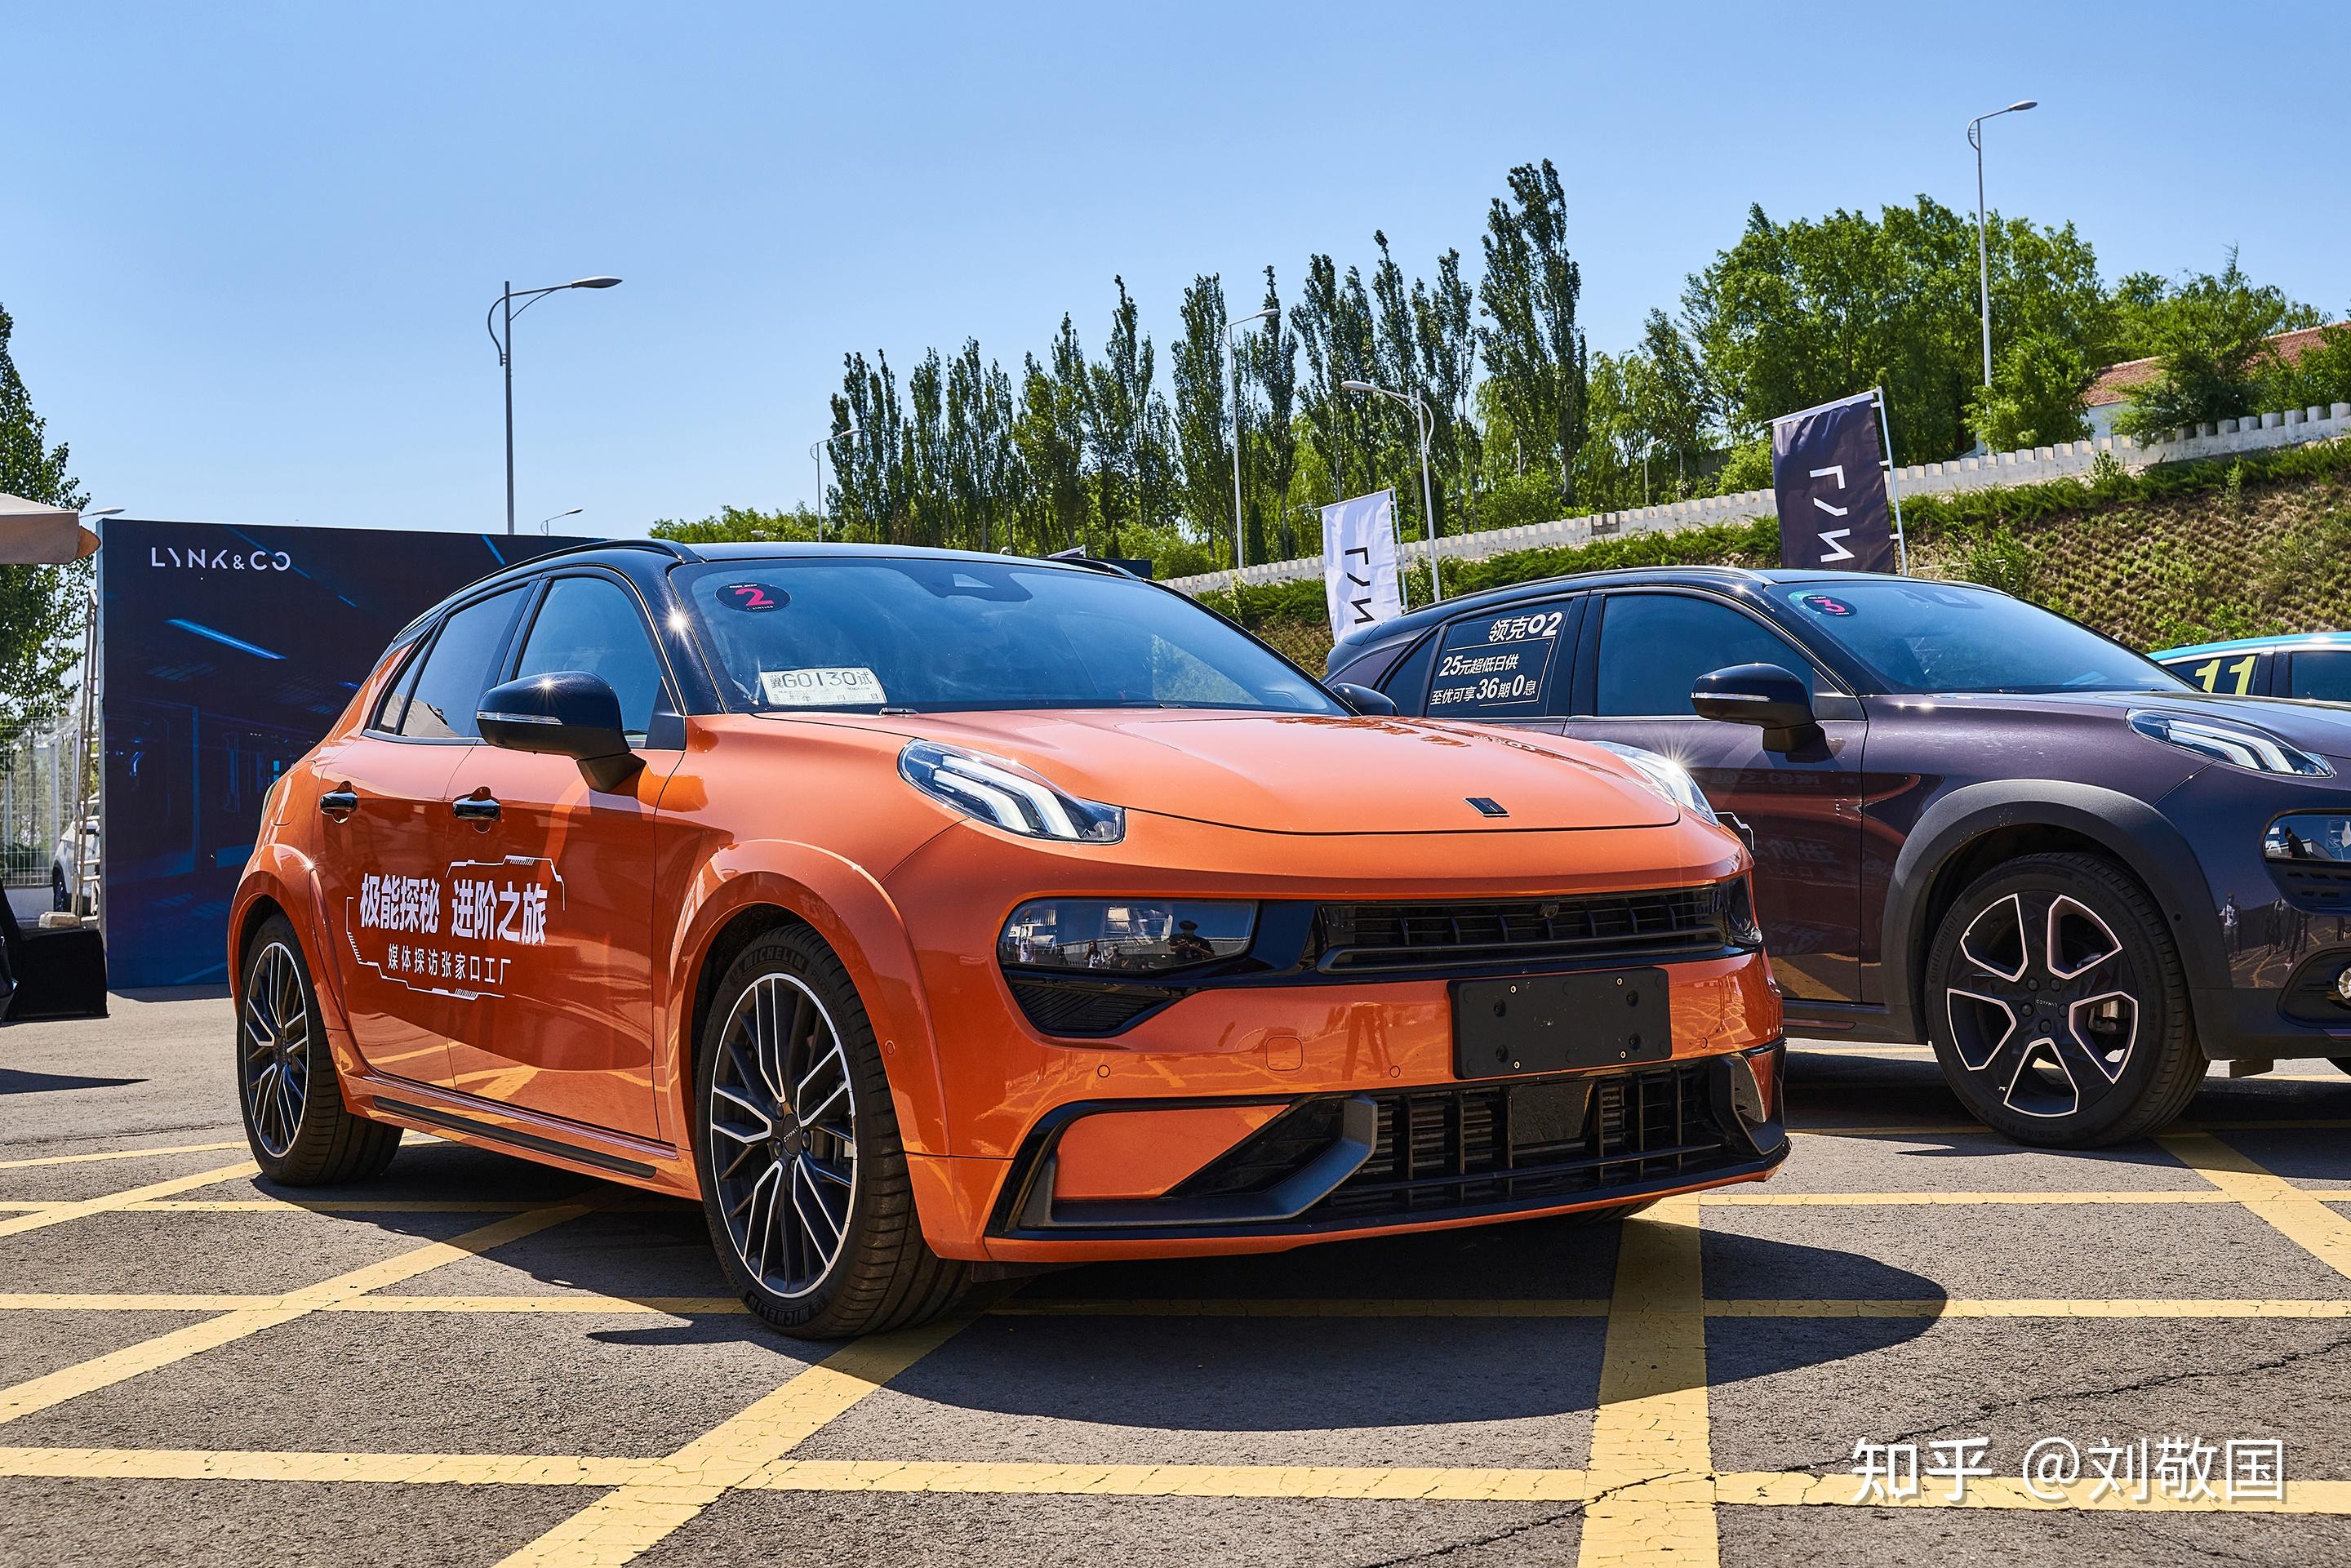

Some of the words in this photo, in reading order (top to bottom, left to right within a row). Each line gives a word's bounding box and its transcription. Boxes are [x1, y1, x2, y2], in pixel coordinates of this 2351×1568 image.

[151, 547, 291, 571] LYNK&CO
[735, 588, 775, 606] 2
[1438, 653, 1519, 677] 25元超低日供
[2194, 655, 2255, 695] 11
[1429, 674, 1536, 706] 至优可享36期0息
[359, 873, 441, 934] 极能探秘
[451, 878, 548, 946] 进阶之旅
[387, 943, 511, 985] 媒体探访张家口工厂
[744, 946, 806, 974] MICHELIN
[748, 1294, 811, 1325] MICHELIN
